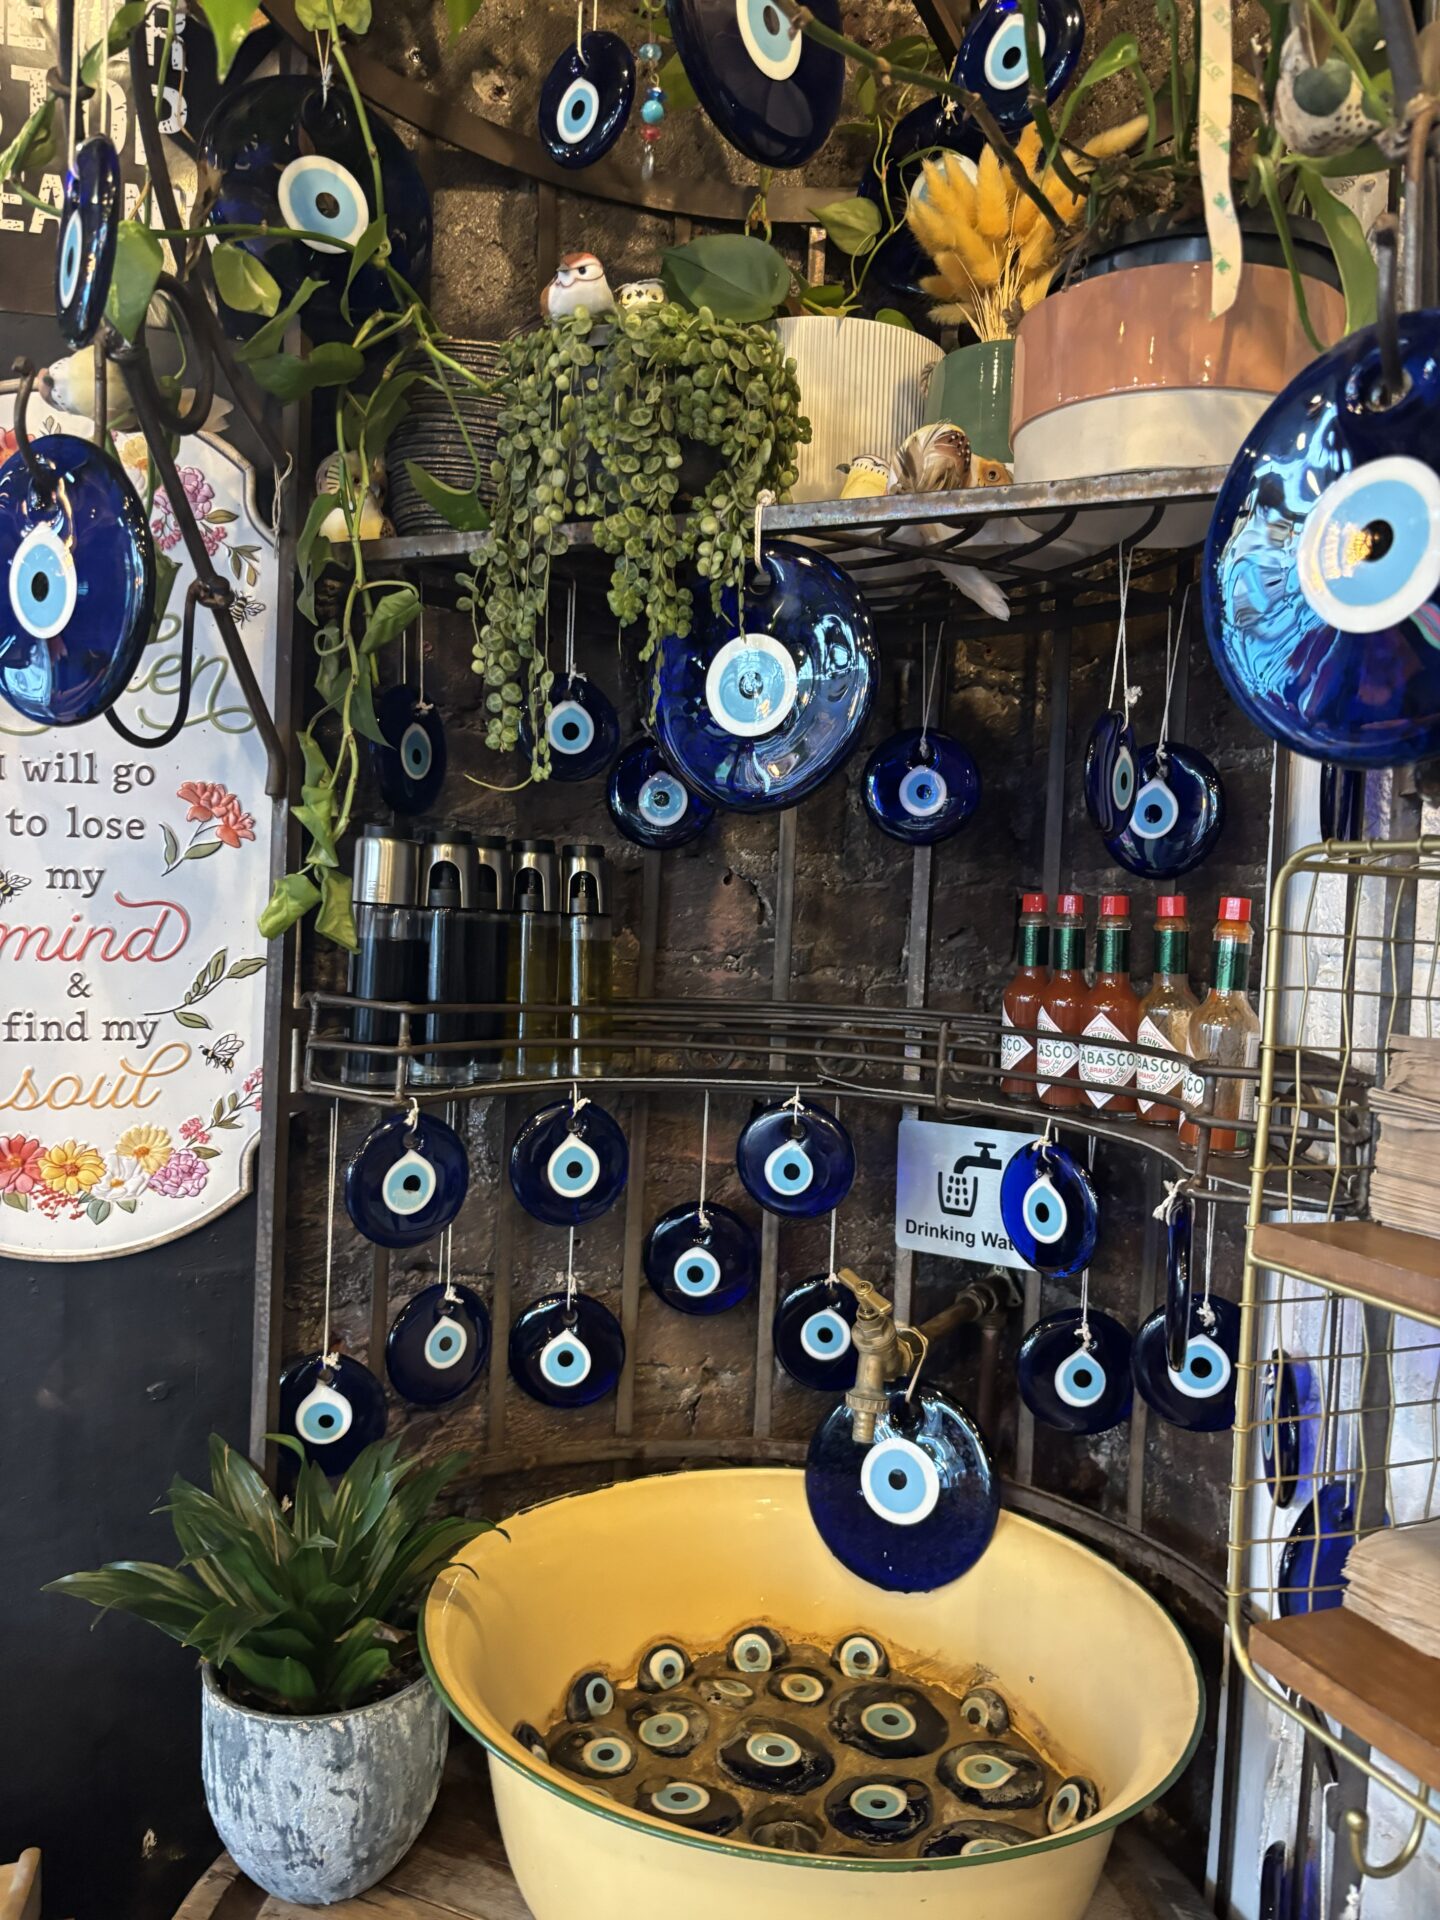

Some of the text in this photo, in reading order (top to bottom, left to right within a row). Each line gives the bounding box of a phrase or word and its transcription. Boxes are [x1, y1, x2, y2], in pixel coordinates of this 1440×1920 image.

[22, 751, 98, 784] will
[113, 764, 155, 793] go
[6, 808, 145, 838] to lose
[46, 868, 104, 898] my
[0, 891, 190, 962] mind
[67, 973, 91, 998] &
[2, 1012, 158, 1048] find my
[1039, 1044, 1073, 1059] ASCO
[1080, 1051, 1135, 1066] ABASCO
[0, 1042, 191, 1111] soul
[905, 1218, 1015, 1251] Drinking Wat
